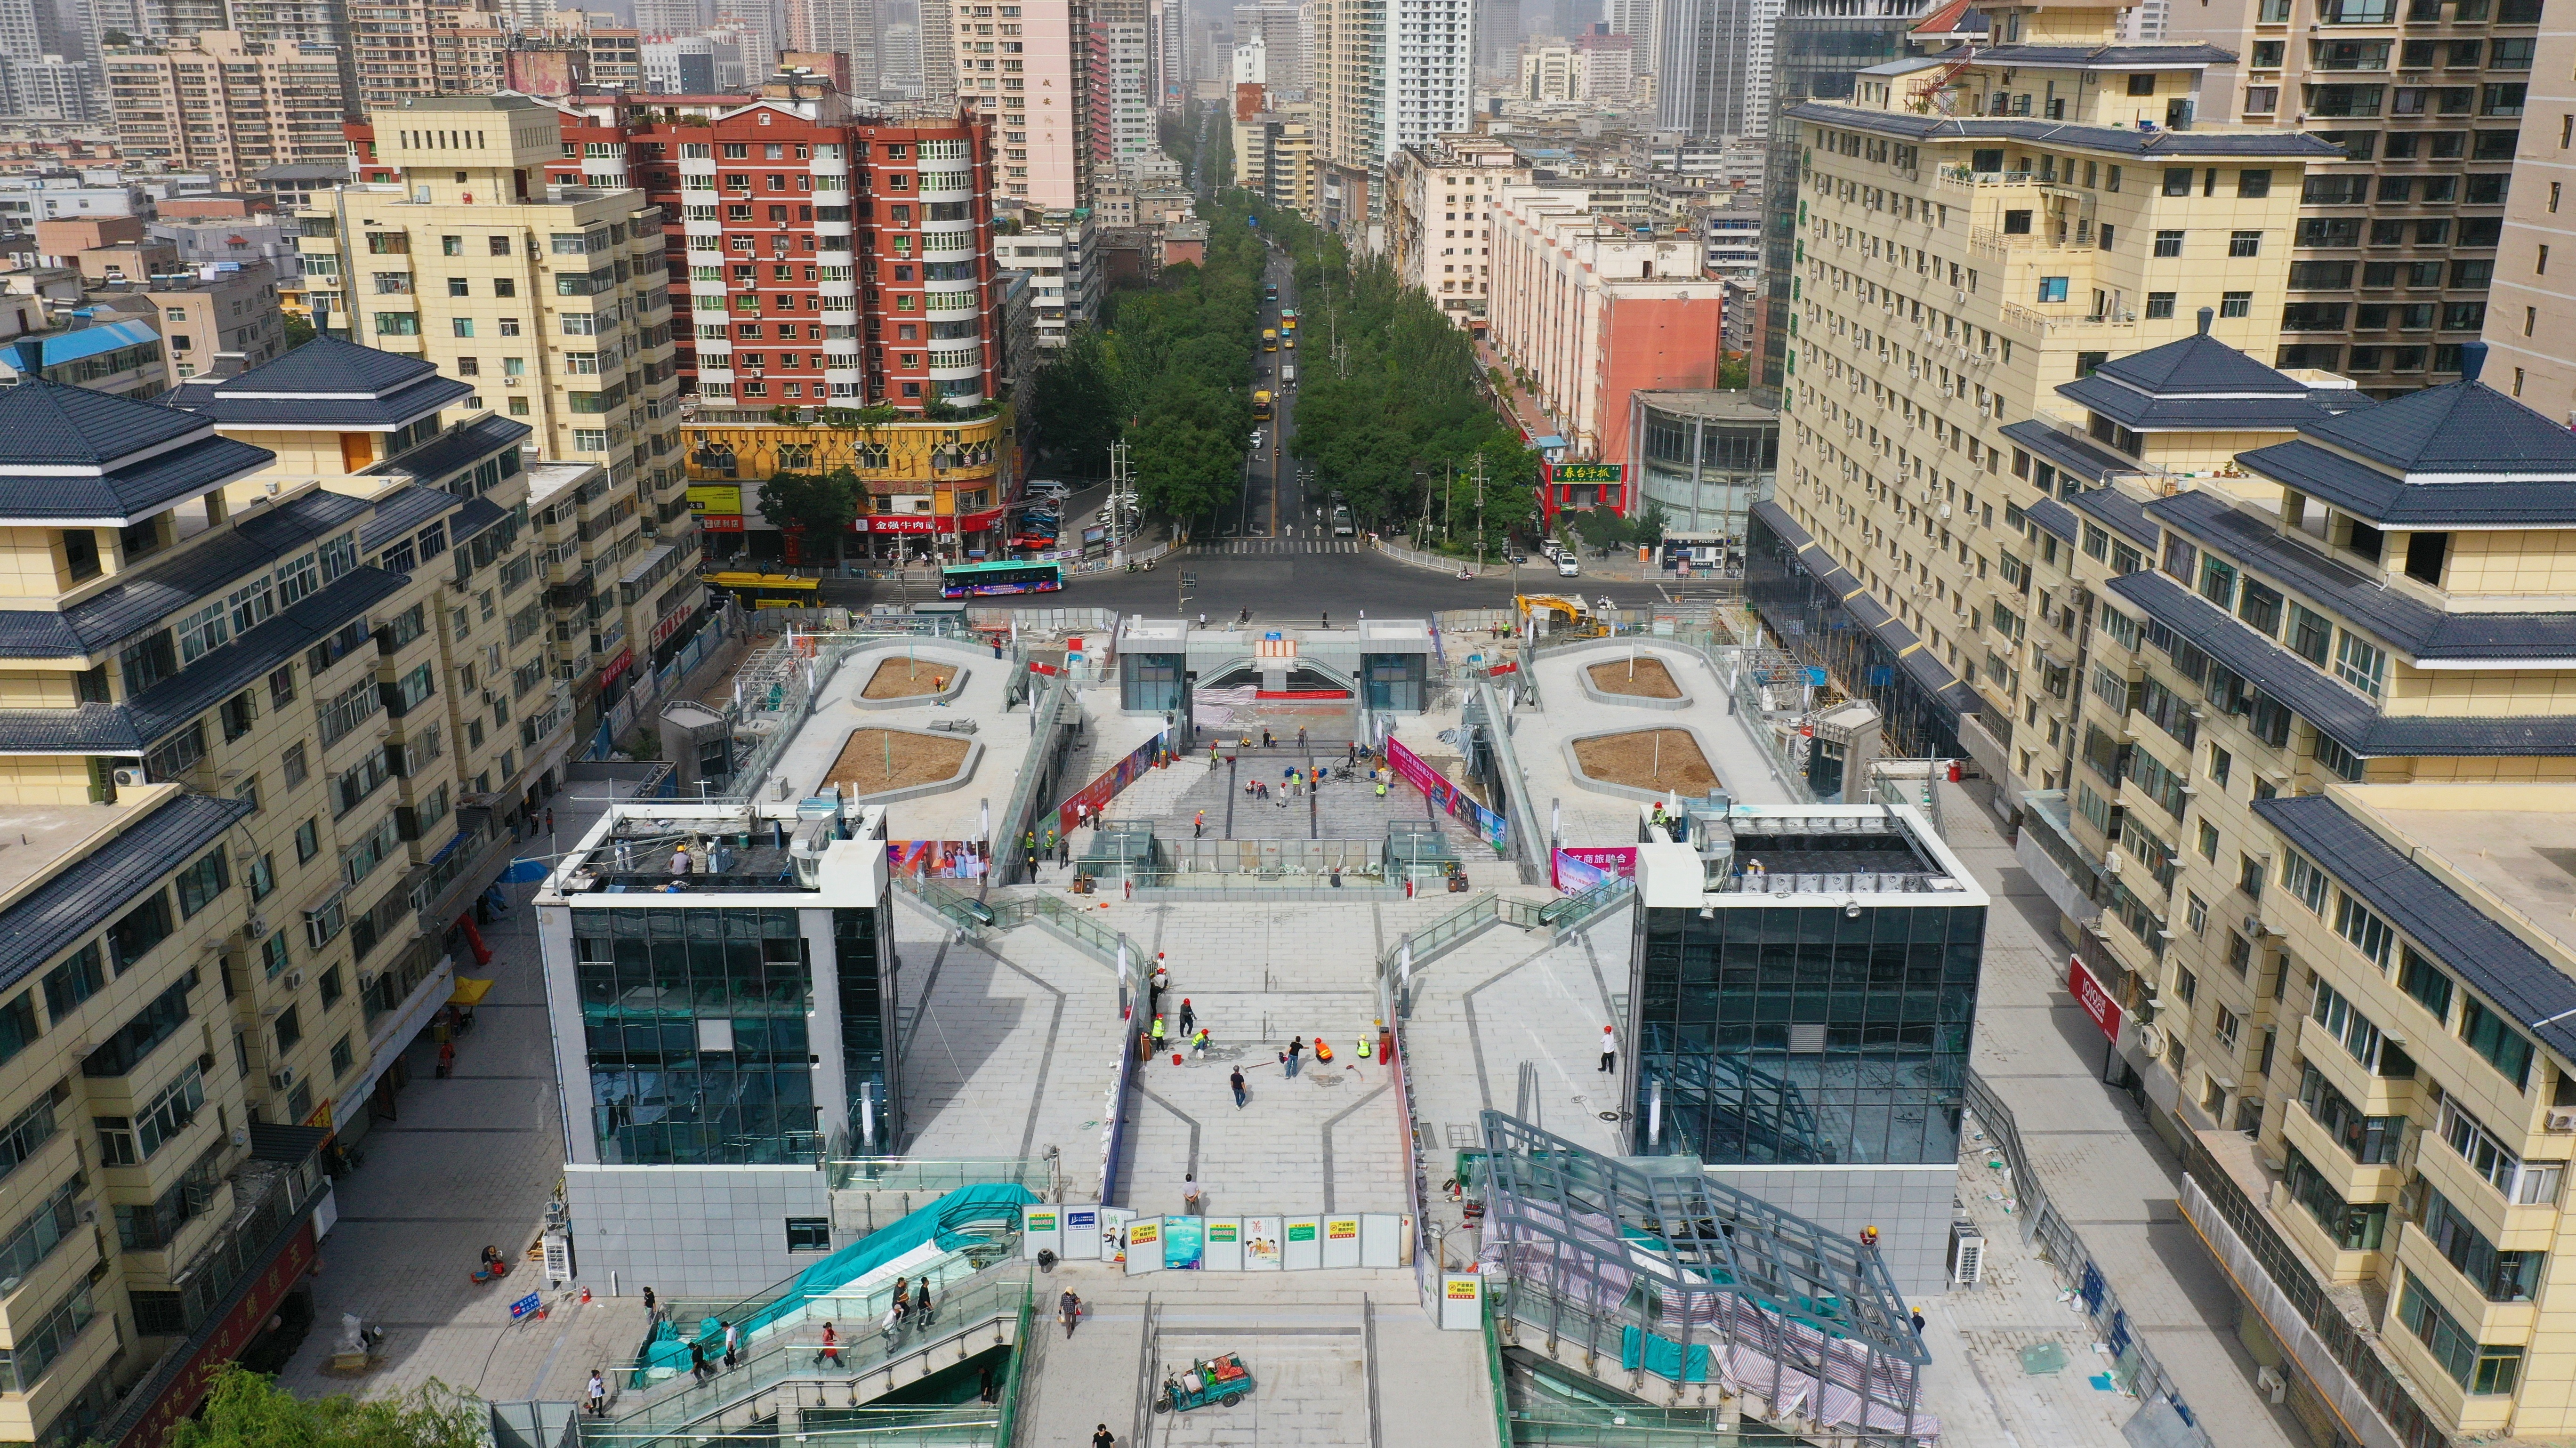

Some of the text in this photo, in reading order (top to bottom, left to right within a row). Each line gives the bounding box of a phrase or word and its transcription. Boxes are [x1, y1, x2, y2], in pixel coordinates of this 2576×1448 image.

[714, 519, 739, 528] 便利店
[876, 521, 938, 530] 金强牛肉面
[1108, 1214, 1118, 1225] 诚
[1252, 1220, 1263, 1233] 善
[521, 1301, 539, 1312] 禁止入内
